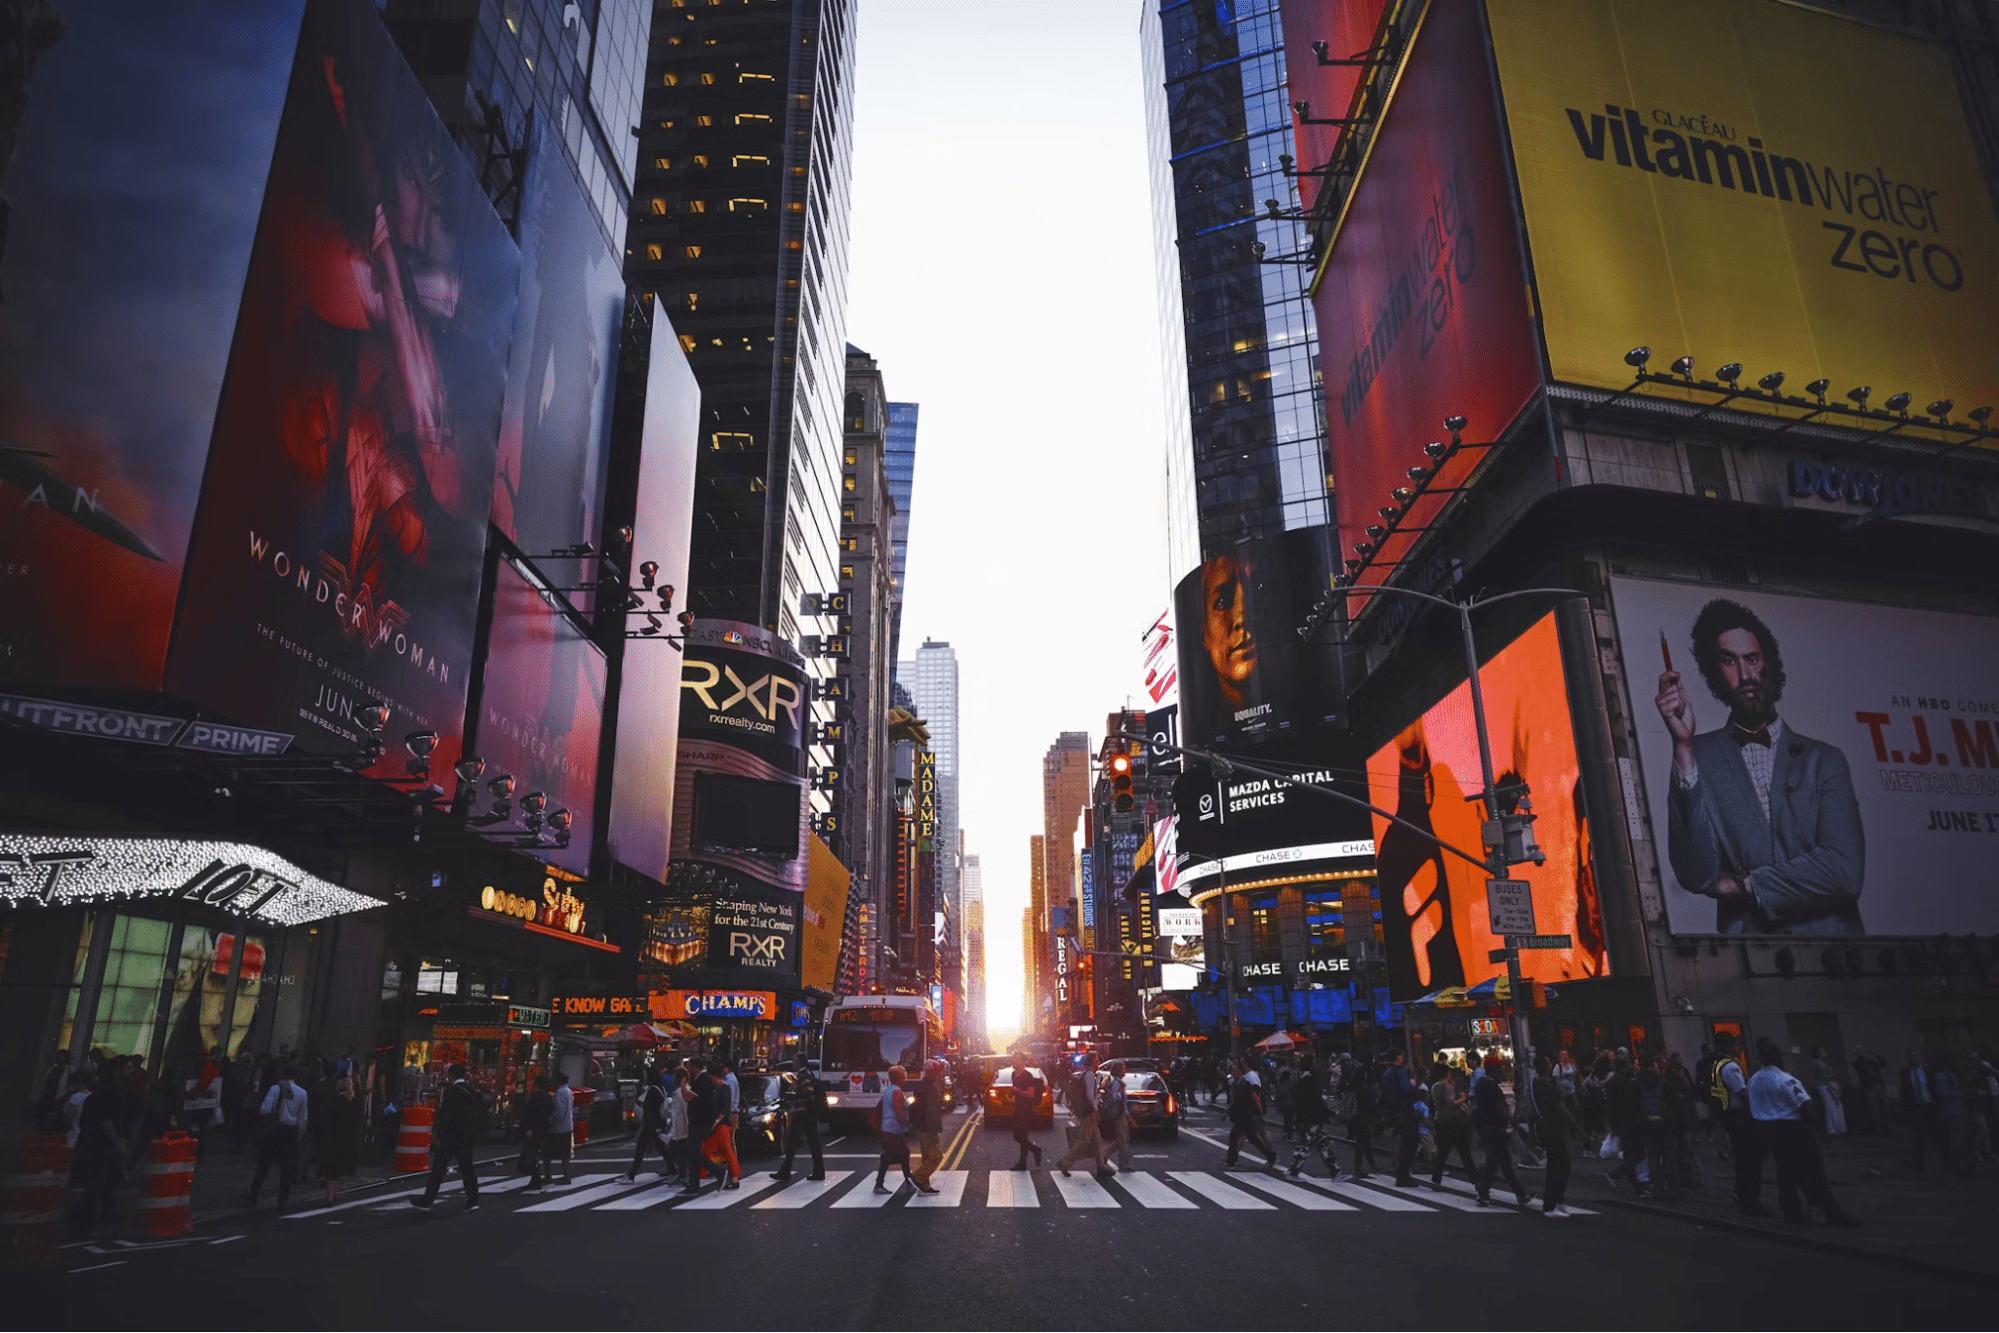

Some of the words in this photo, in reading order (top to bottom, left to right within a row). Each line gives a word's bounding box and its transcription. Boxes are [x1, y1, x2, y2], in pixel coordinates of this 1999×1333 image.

[1565, 103, 1939, 234] vitaminwater
[1822, 220, 1964, 292] zero
[1418, 224, 1475, 361] zero
[1788, 461, 1883, 504] DOW
[0, 563, 29, 576] ER
[250, 530, 361, 629] WONDER
[379, 618, 449, 684] WOMAN
[256, 623, 274, 641] THE
[279, 635, 313, 663] FUTURE
[317, 657, 328, 671] OF
[331, 666, 364, 691] JUSTICE
[314, 684, 361, 721] JUN
[680, 659, 799, 731] RXR
[1892, 694, 1911, 708] AN
[1917, 697, 1950, 710] HBO
[708, 713, 776, 735] rxrrealty.com
[824, 596, 846, 832] CHAMPS
[193, 726, 281, 755] PRIME
[1855, 711, 1950, 766] T.J.
[1949, 718, 1999, 768] M
[919, 751, 935, 837] MADAME
[1229, 779, 1271, 798] MAZDA
[1229, 791, 1285, 813] SERVICES
[1927, 810, 1982, 833] JUNE
[1255, 850, 1291, 863] CHASE
[1495, 884, 1522, 894] BUSES
[716, 899, 757, 915] Shaping
[758, 902, 778, 914] New
[778, 904, 793, 917] York
[1083, 893, 1095, 927] STUDIOS
[1499, 896, 1520, 906] ONLY
[714, 914, 731, 925] for
[733, 914, 749, 926] the
[750, 916, 768, 929] 21st
[768, 917, 794, 934] Century
[1140, 892, 1153, 938] VICTORY
[729, 931, 785, 960] RXR
[1529, 936, 1569, 949] Broadway
[741, 957, 777, 967] REALTY
[1056, 937, 1068, 1002] REGAL
[1243, 962, 1281, 977] CHASE
[1299, 958, 1350, 973] CHASE
[565, 997, 605, 1014] KNOW
[685, 993, 766, 1015] CHAMPS
[1472, 1019, 1499, 1035] SODA
